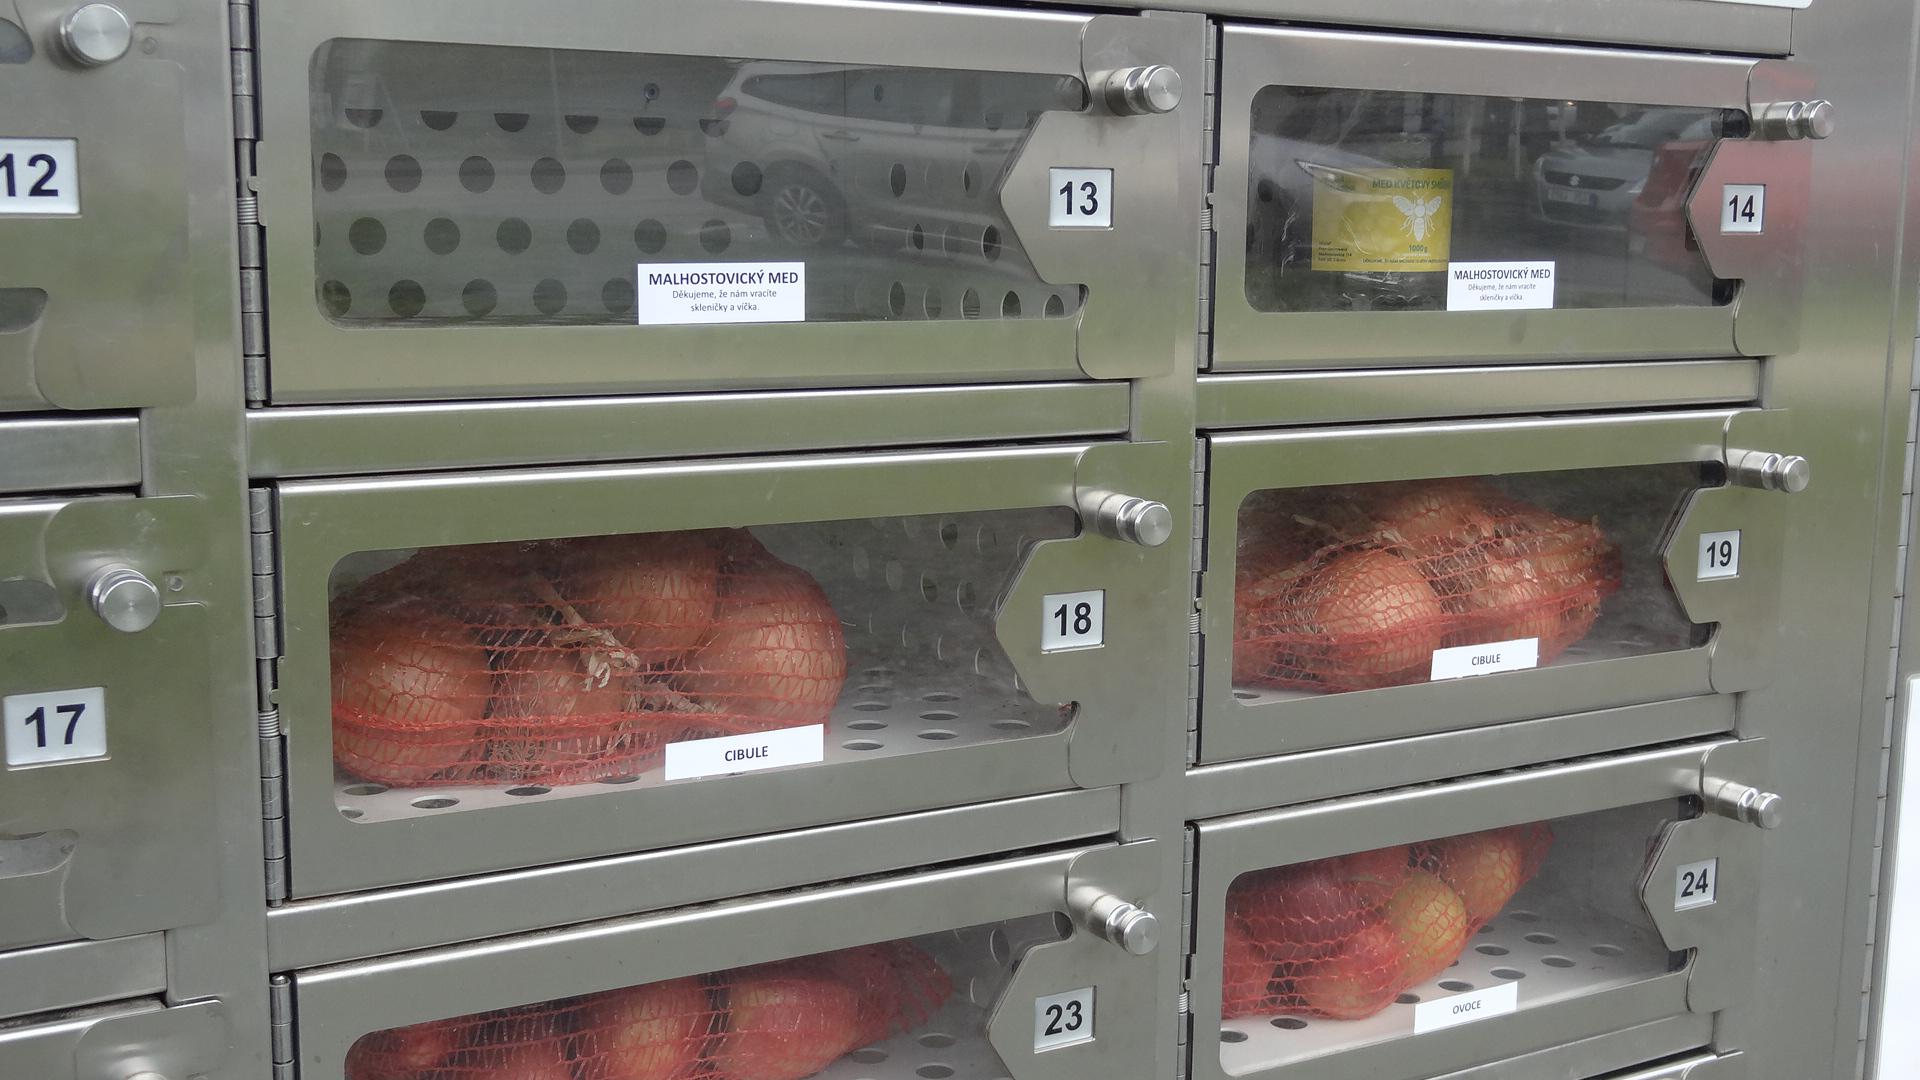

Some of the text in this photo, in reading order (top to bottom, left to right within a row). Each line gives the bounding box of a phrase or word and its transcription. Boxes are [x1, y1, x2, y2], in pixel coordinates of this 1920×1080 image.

[0, 153, 59, 197] 12
[1060, 181, 1098, 216] 13
[1729, 194, 1755, 222] 14
[649, 269, 798, 285] MALHOSTOVICKÝ MED
[1454, 267, 1551, 280] MALHOSTOVICKÝ MED
[672, 290, 717, 300] Děkujeme,
[719, 289, 728, 298] že
[730, 289, 748, 298] nám
[690, 303, 727, 312] skleničky
[1706, 540, 1732, 568] 19
[1054, 602, 1092, 636] 18
[1471, 653, 1501, 666] CIBULE
[25, 703, 86, 748] 17
[724, 745, 769, 762] CIBULE
[1681, 868, 1709, 898] 24
[1044, 1000, 1083, 1036] 23
[1452, 1000, 1482, 1014] OVOCE
